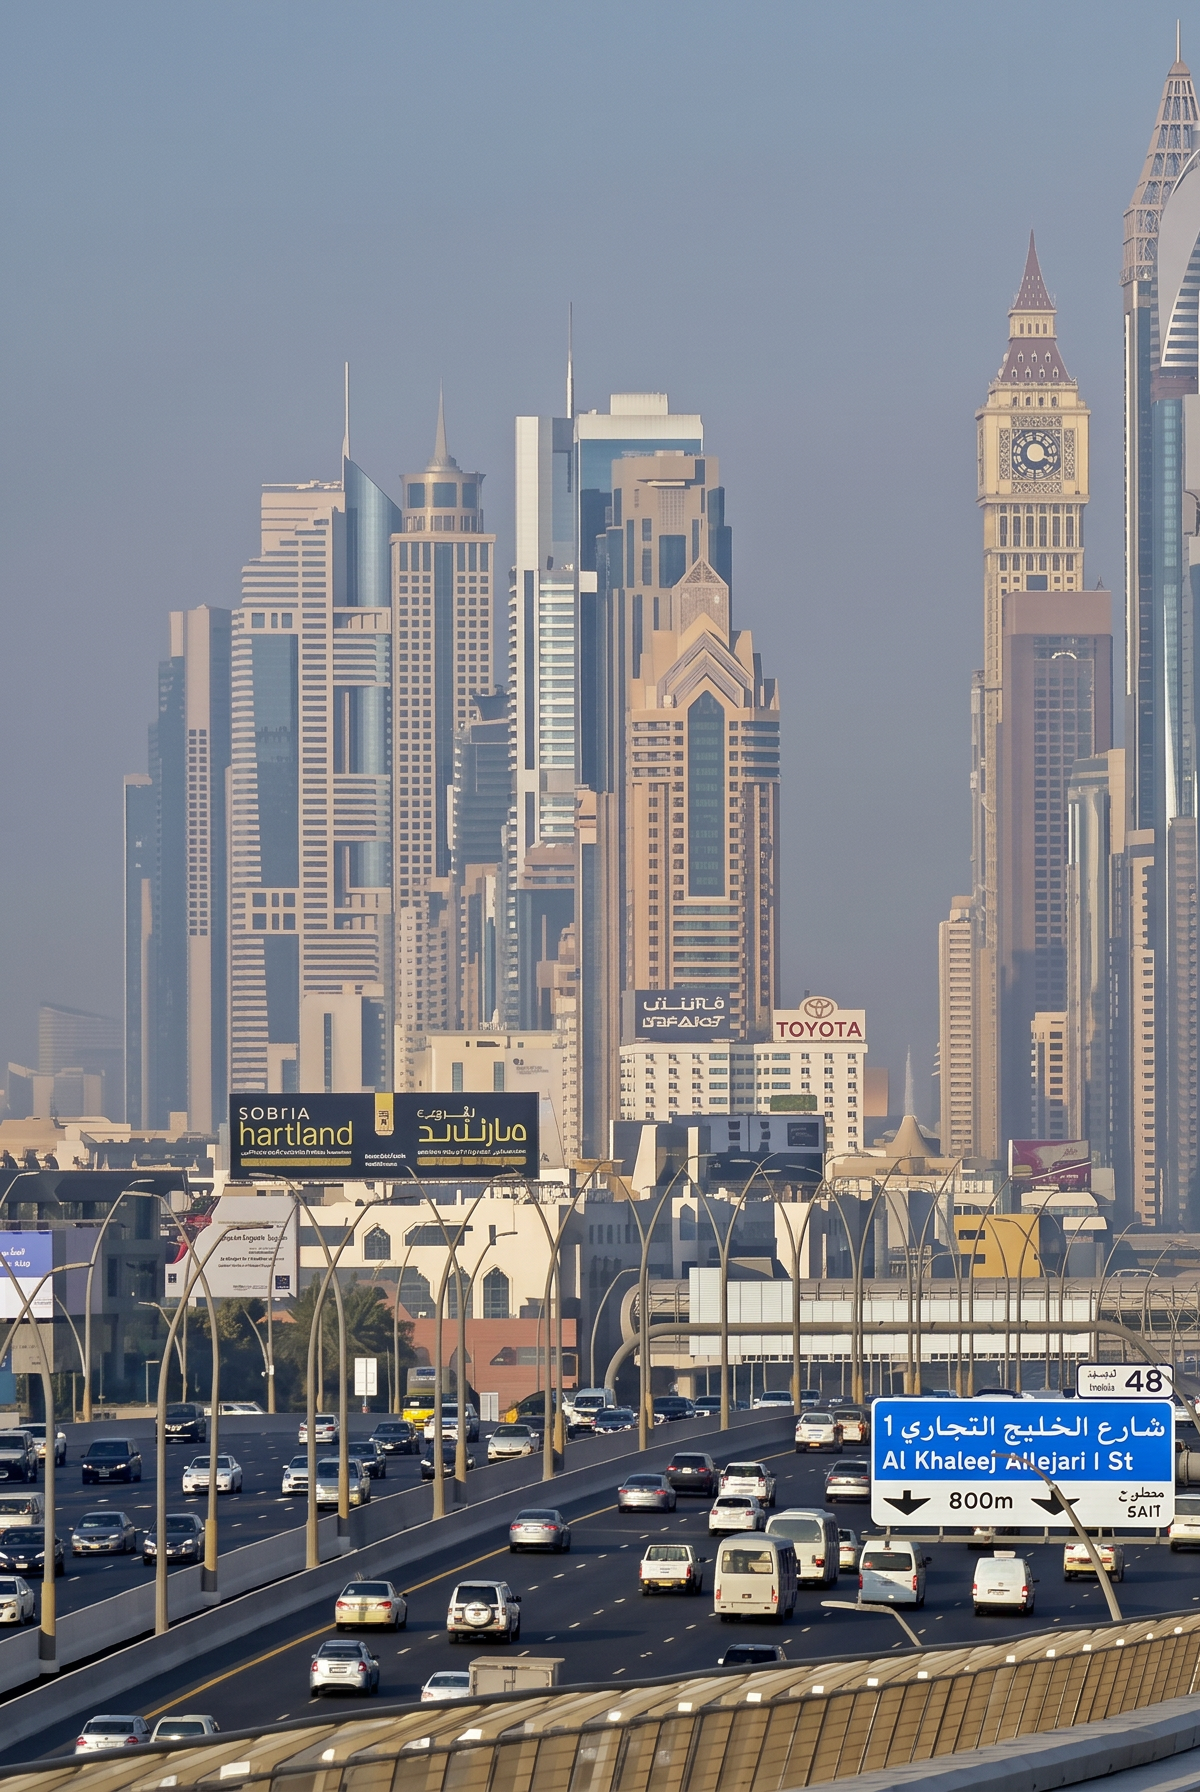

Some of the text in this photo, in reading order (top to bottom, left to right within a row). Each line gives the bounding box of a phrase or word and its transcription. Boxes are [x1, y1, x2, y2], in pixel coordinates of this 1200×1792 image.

[775, 1021, 863, 1038] TOYOTA
[239, 1120, 353, 1146] hartland
[1124, 1369, 1163, 1393] 48
[883, 1414, 1166, 1446] شارع الخليج التجاري 1
[882, 1450, 906, 1470] Al
[915, 1450, 997, 1474] Khaleej
[1108, 1450, 1134, 1471] St
[949, 1491, 1013, 1510] 800m
